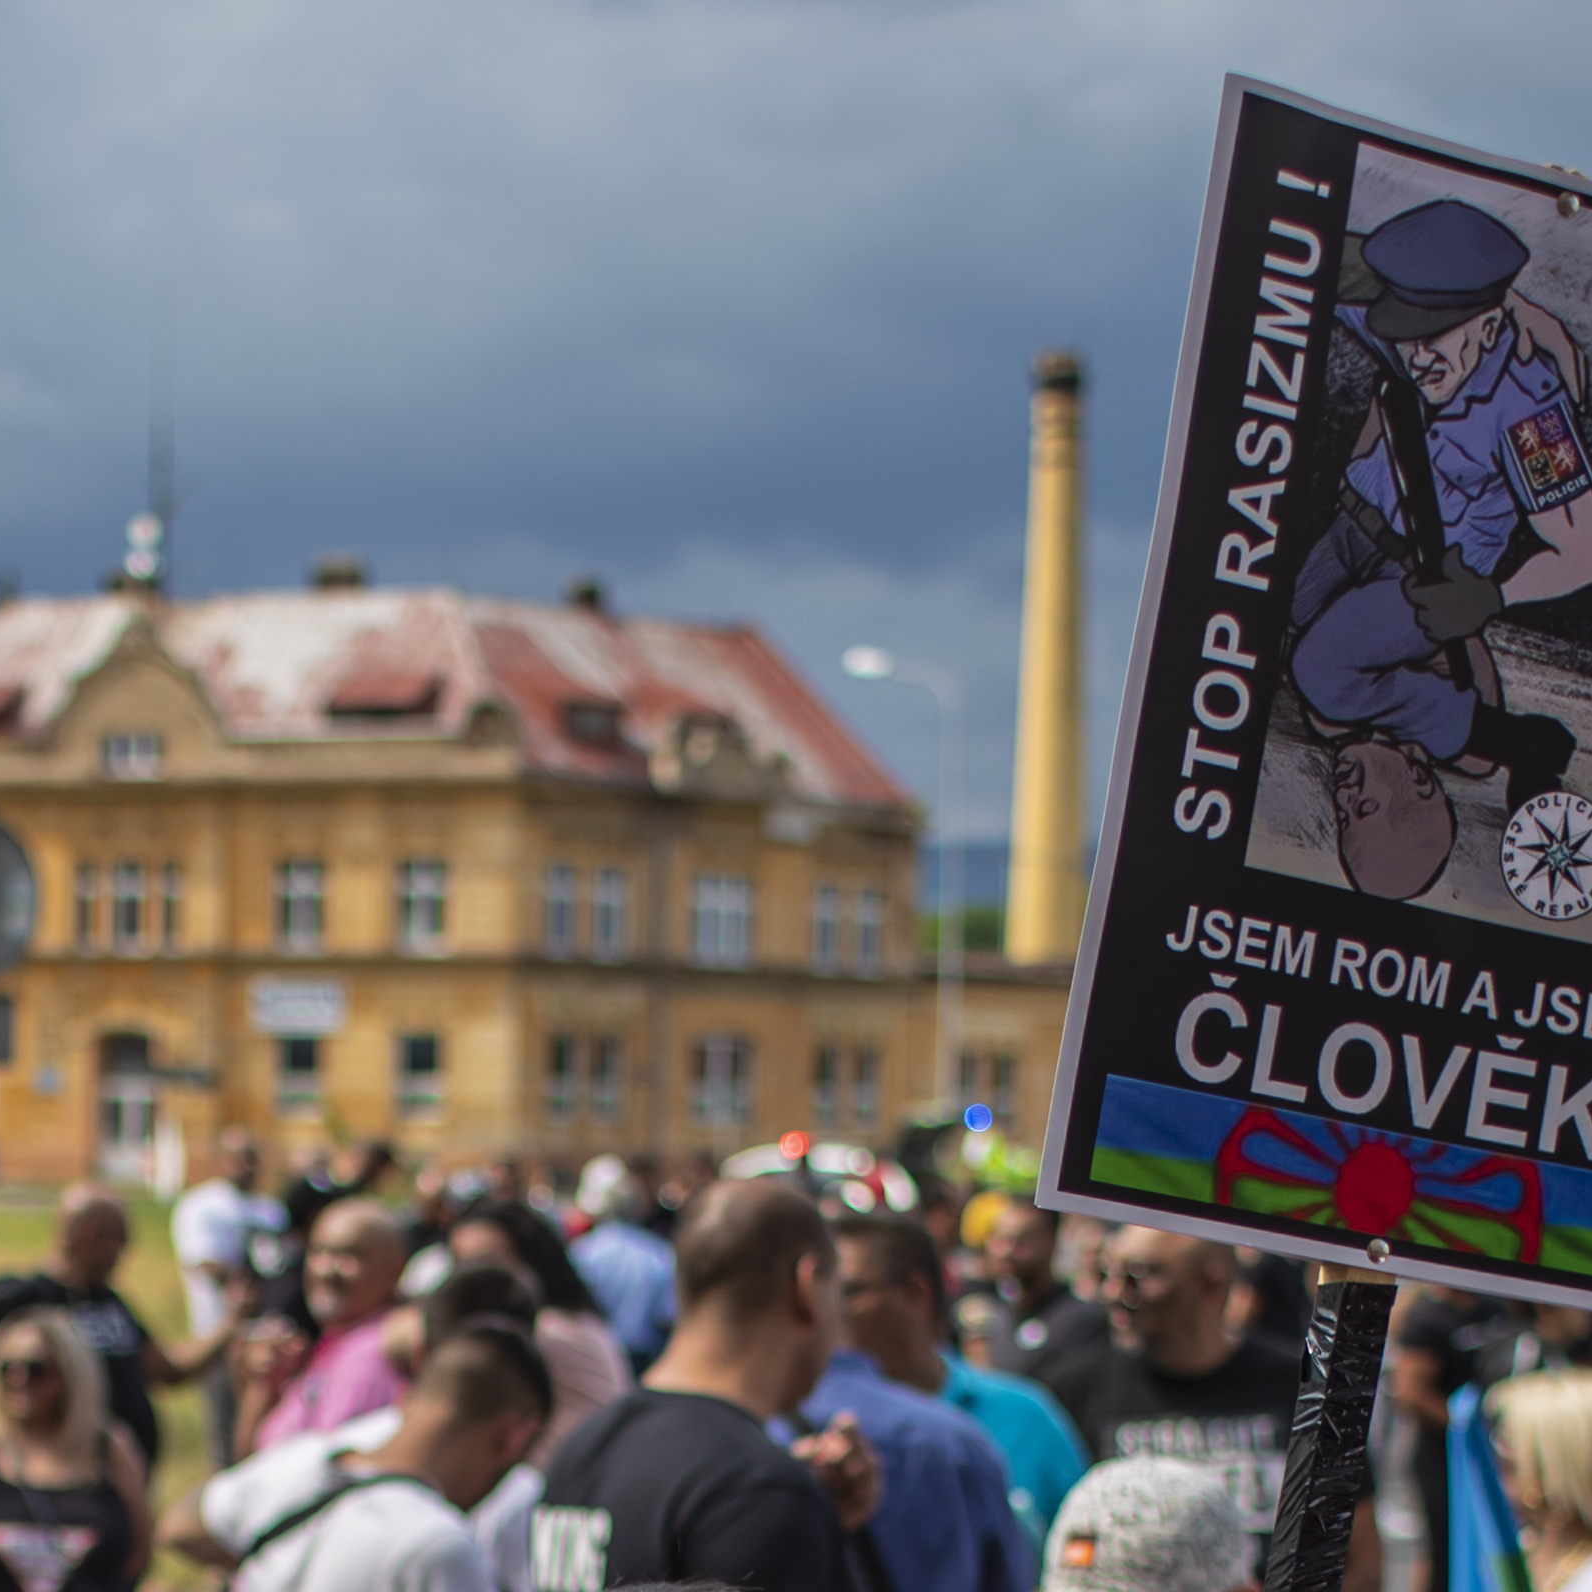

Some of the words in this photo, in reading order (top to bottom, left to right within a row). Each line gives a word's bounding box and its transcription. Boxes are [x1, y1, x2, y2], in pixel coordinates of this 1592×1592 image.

[1277, 170, 1330, 198] !
[1215, 219, 1322, 590] RASIZMU
[1536, 473, 1589, 507] POLICIE
[1174, 613, 1257, 839] STOP
[1166, 905, 1317, 978] JSEM
[1331, 938, 1451, 1009] ROM
[1461, 971, 1497, 1019] A
